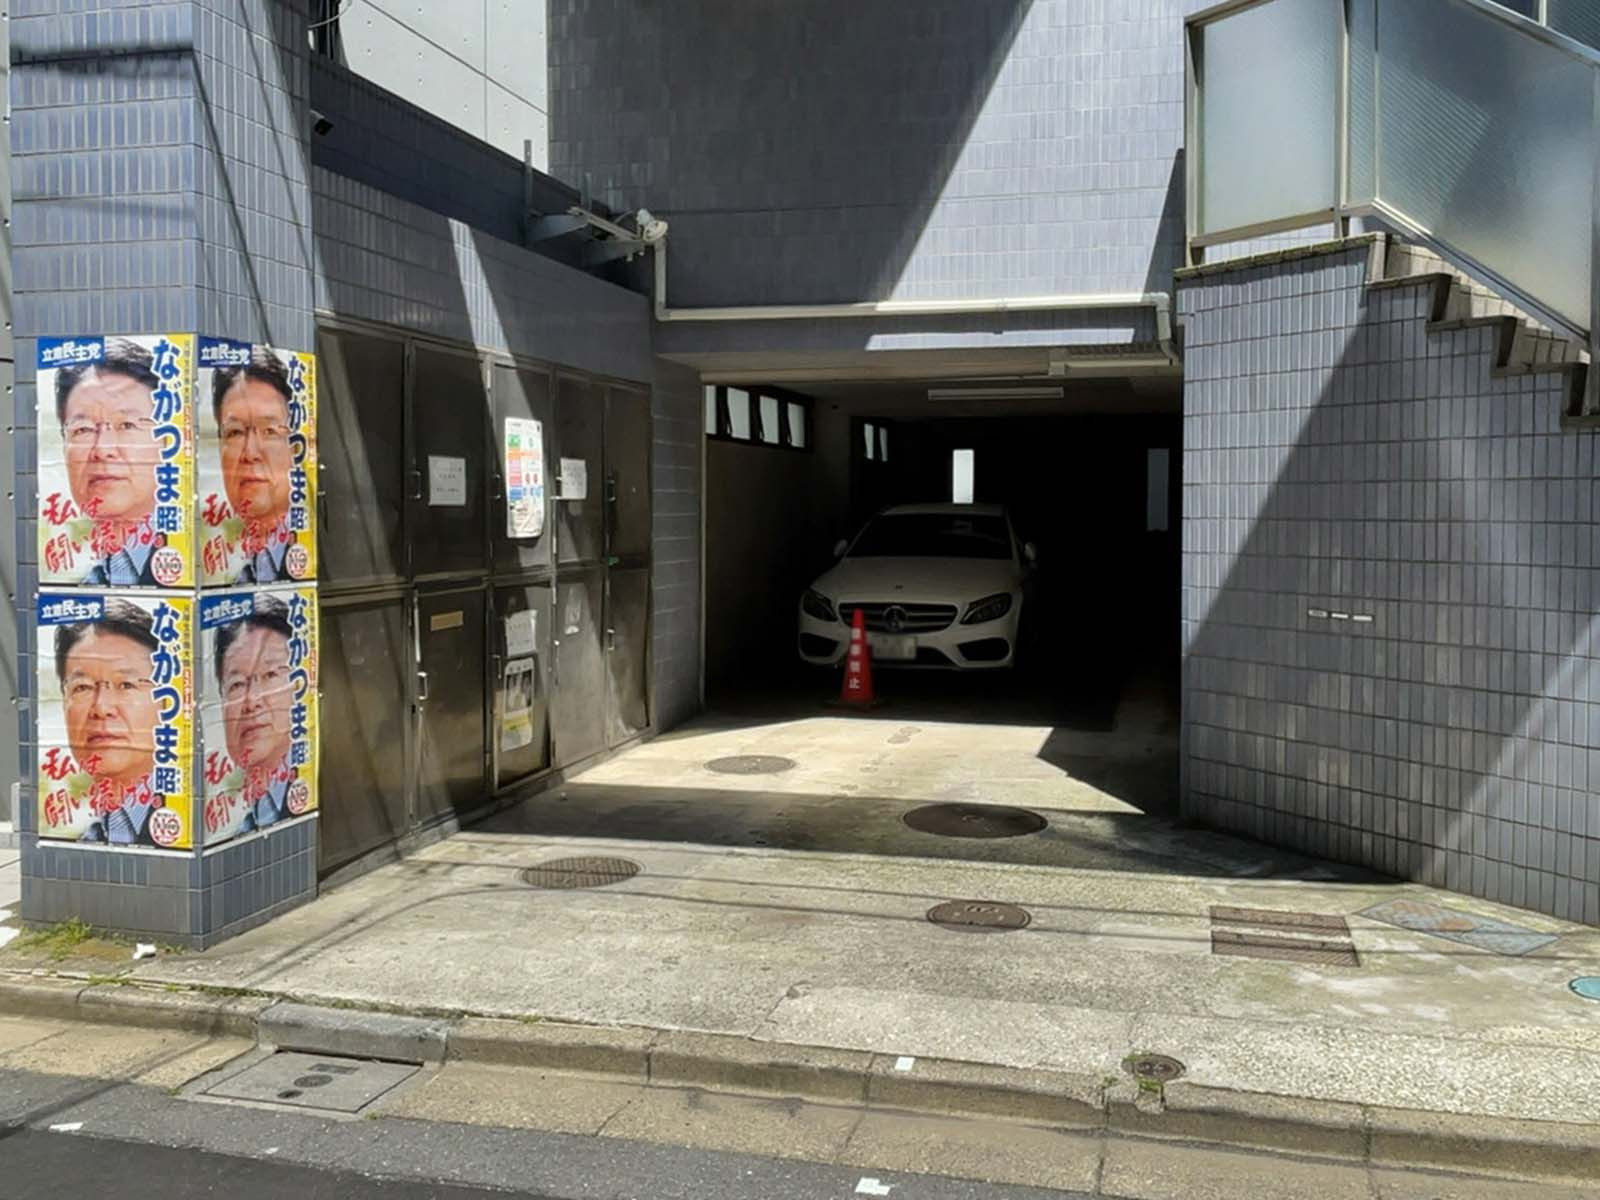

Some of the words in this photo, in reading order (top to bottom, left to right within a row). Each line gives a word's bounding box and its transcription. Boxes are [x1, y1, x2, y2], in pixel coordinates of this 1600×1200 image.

[42, 492, 104, 526] 私は
[152, 339, 182, 531] ながつま昭
[288, 356, 308, 531] ながつま昭
[41, 747, 103, 781] 私は
[152, 602, 181, 794] ながつま昭
[289, 591, 309, 765] ながつま昭
